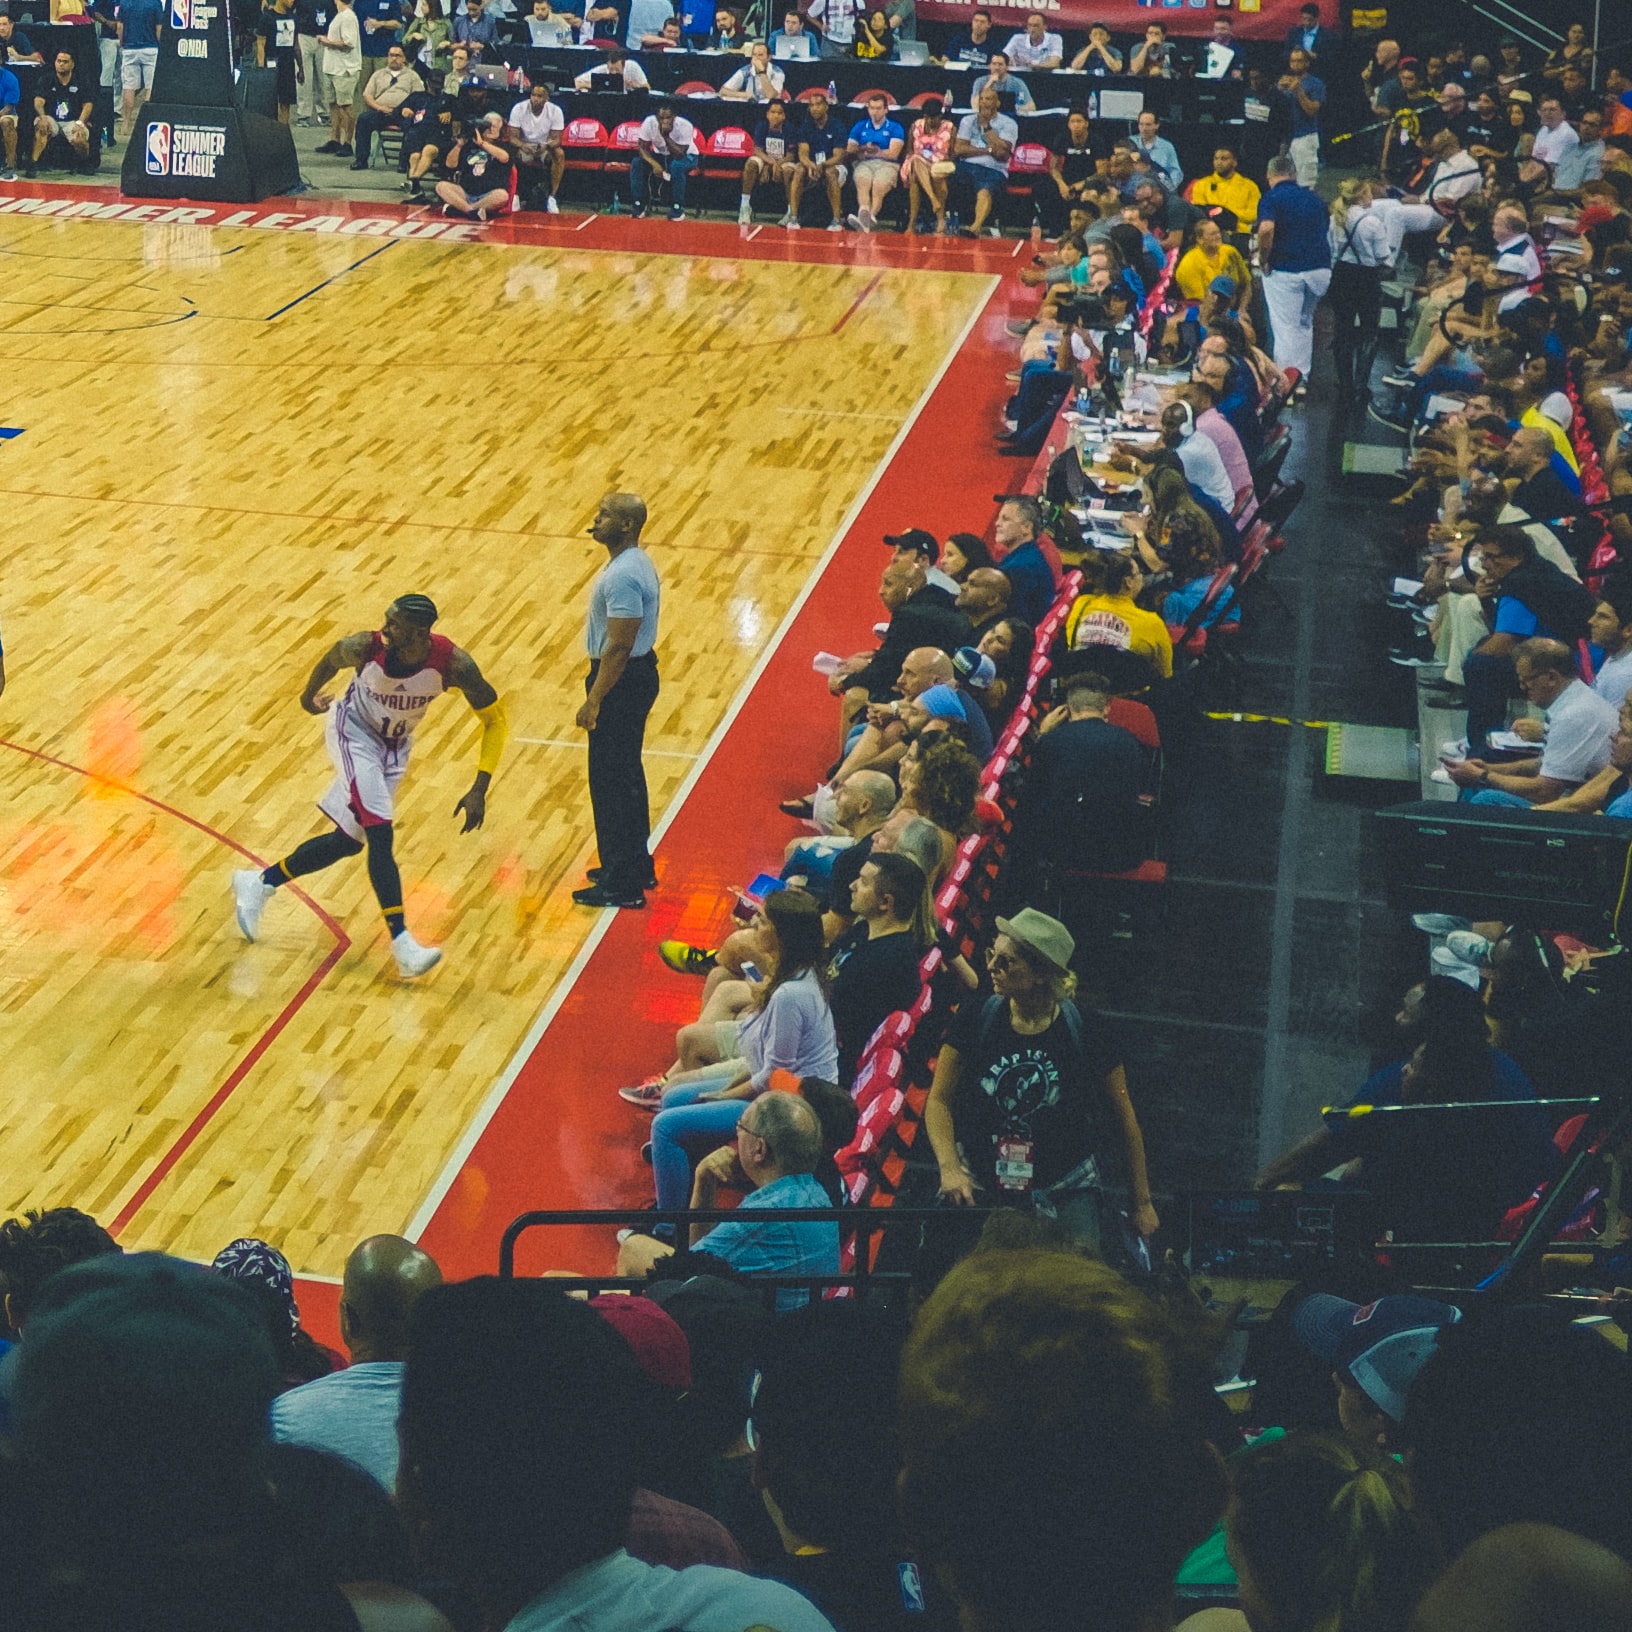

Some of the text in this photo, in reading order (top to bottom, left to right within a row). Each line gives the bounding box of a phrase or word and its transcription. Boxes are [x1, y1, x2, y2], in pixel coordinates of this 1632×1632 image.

[177, 38, 208, 59] @NBA
[172, 129, 226, 156] SUMMER
[172, 153, 216, 179] LEAGUE
[217, 207, 493, 244] LEAGUE
